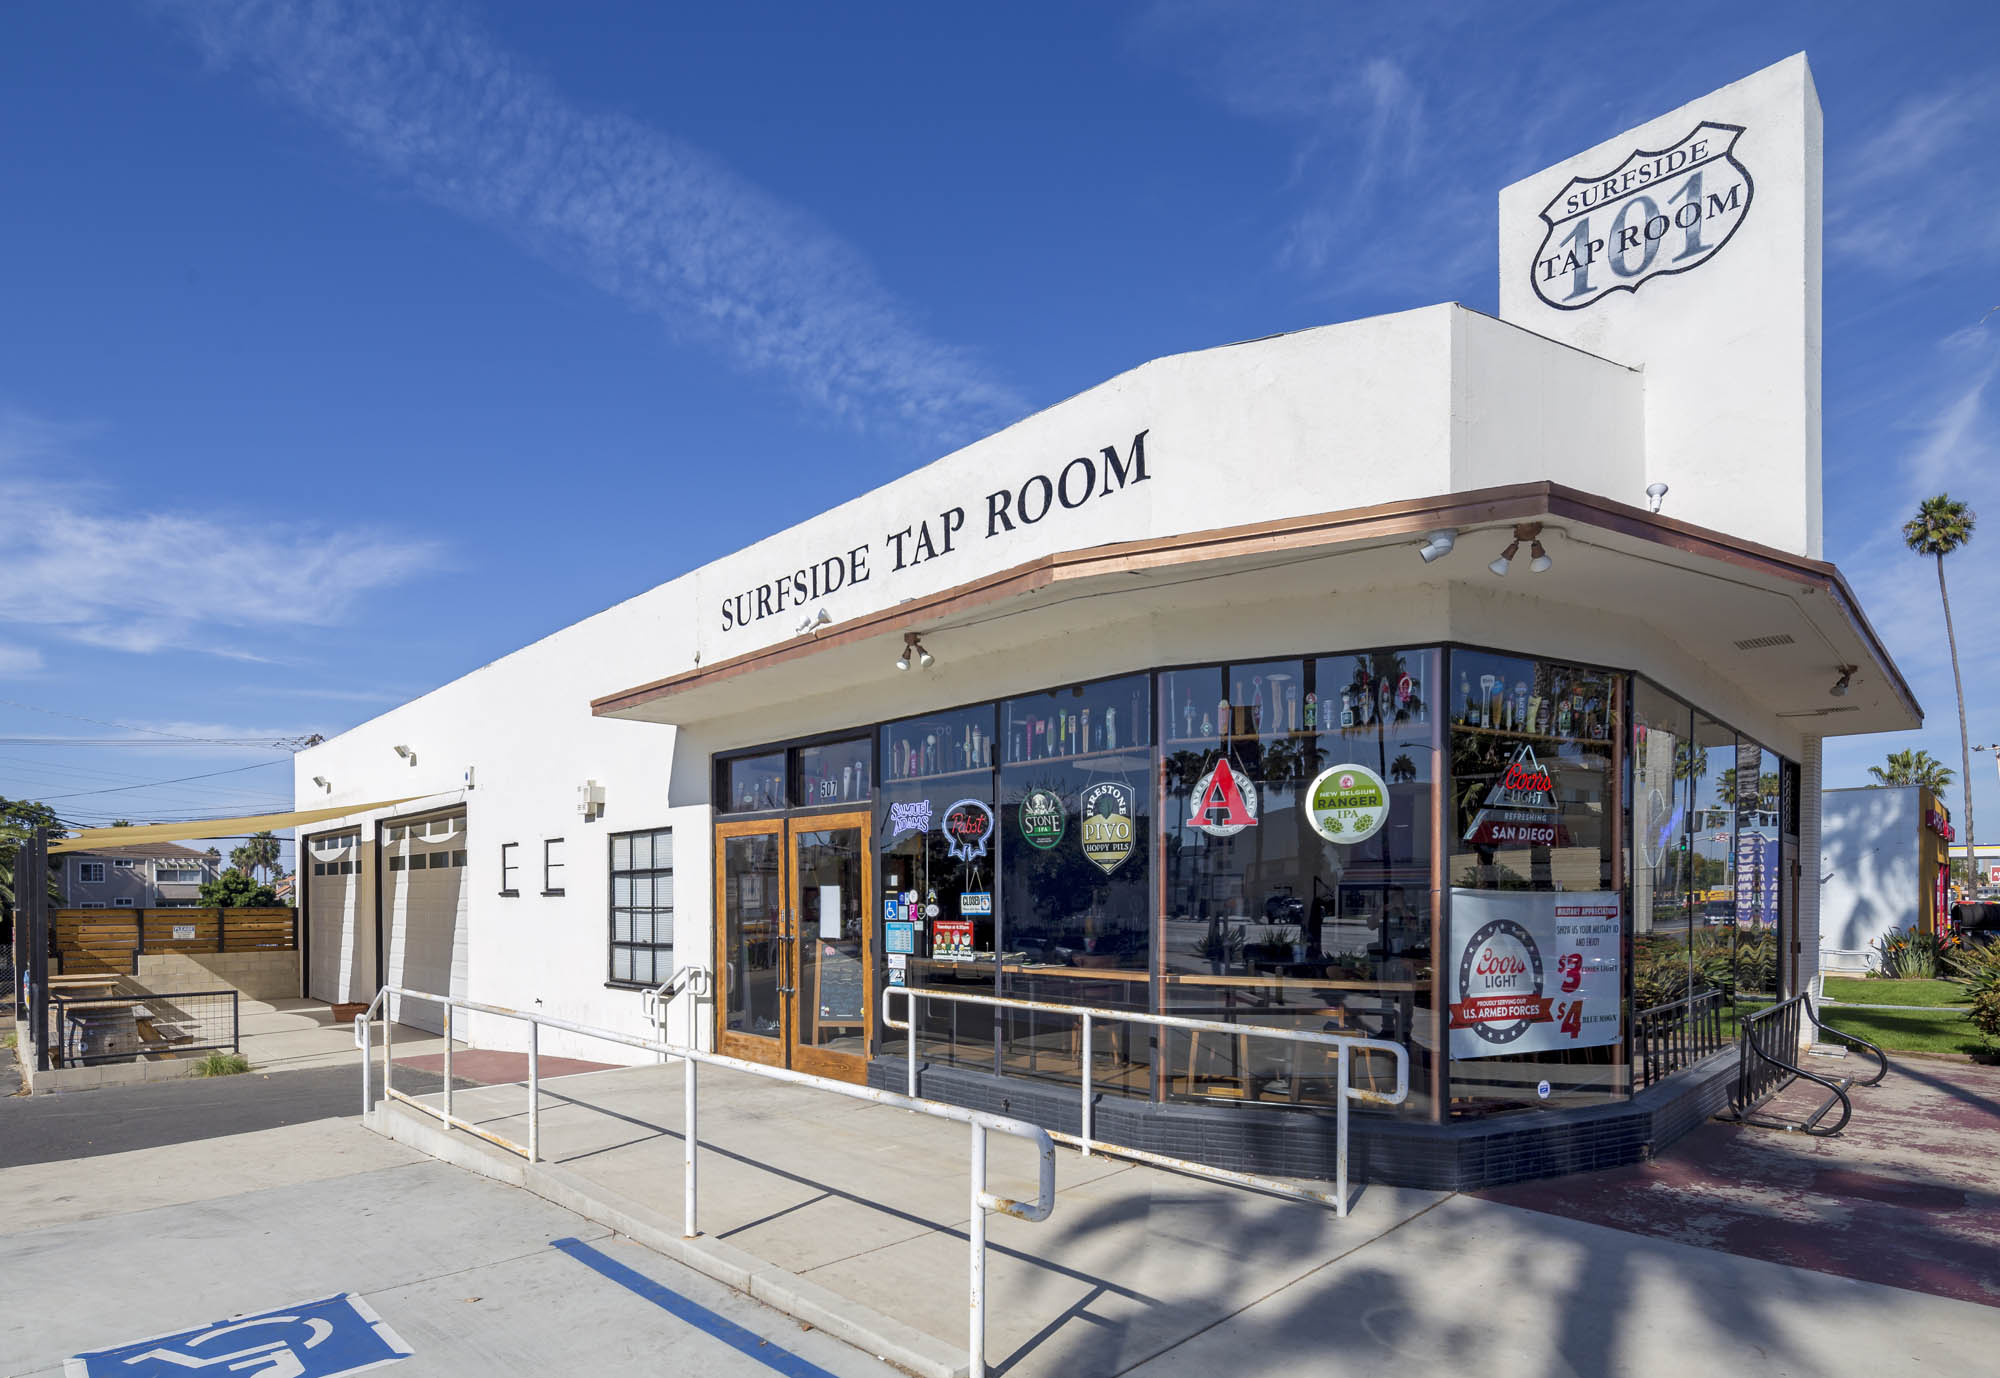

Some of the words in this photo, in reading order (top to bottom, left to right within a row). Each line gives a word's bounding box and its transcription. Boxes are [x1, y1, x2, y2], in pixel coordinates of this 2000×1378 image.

[1566, 138, 1709, 215] SURFSIDE
[1538, 238, 1605, 282] TAP
[1617, 183, 1742, 254] ROOM
[1558, 170, 1714, 302] 101
[720, 543, 871, 633] SURFSIDE
[886, 505, 965, 573] TAP
[985, 428, 1152, 539] ROOM
[1505, 762, 1553, 792] Coors
[820, 781, 838, 797] 507
[1187, 758, 1258, 827] A
[1339, 788, 1376, 796] BELGIUM
[890, 799, 933, 821] SAMUEL
[1086, 784, 1127, 817] FIRESTONE
[1317, 796, 1378, 809] RANGER
[951, 812, 987, 835] Pabst
[1025, 815, 1061, 834] STONE
[1337, 809, 1359, 819] IPA
[1504, 811, 1548, 822] REFRESHING
[893, 816, 929, 837] ADAMS
[1084, 822, 1130, 841] PIVO
[1491, 825, 1516, 840] SAN
[1518, 827, 1554, 841] DIEGO
[1086, 844, 1110, 852] HOPPY
[1112, 842, 1129, 851] PILS
[1556, 926, 1570, 935] SHOW
[1571, 925, 1579, 934] US
[1580, 925, 1592, 934] YOUR
[1592, 924, 1612, 934] MILITARY
[1476, 947, 1527, 975] Coors
[1485, 974, 1518, 989] LIGHT
[1557, 953, 1583, 993] $3
[1463, 1009, 1477, 1019] U.S.
[1478, 1006, 1508, 1018] ARMED
[1508, 1004, 1540, 1016] FORCES
[1557, 1000, 1583, 1039] $4
